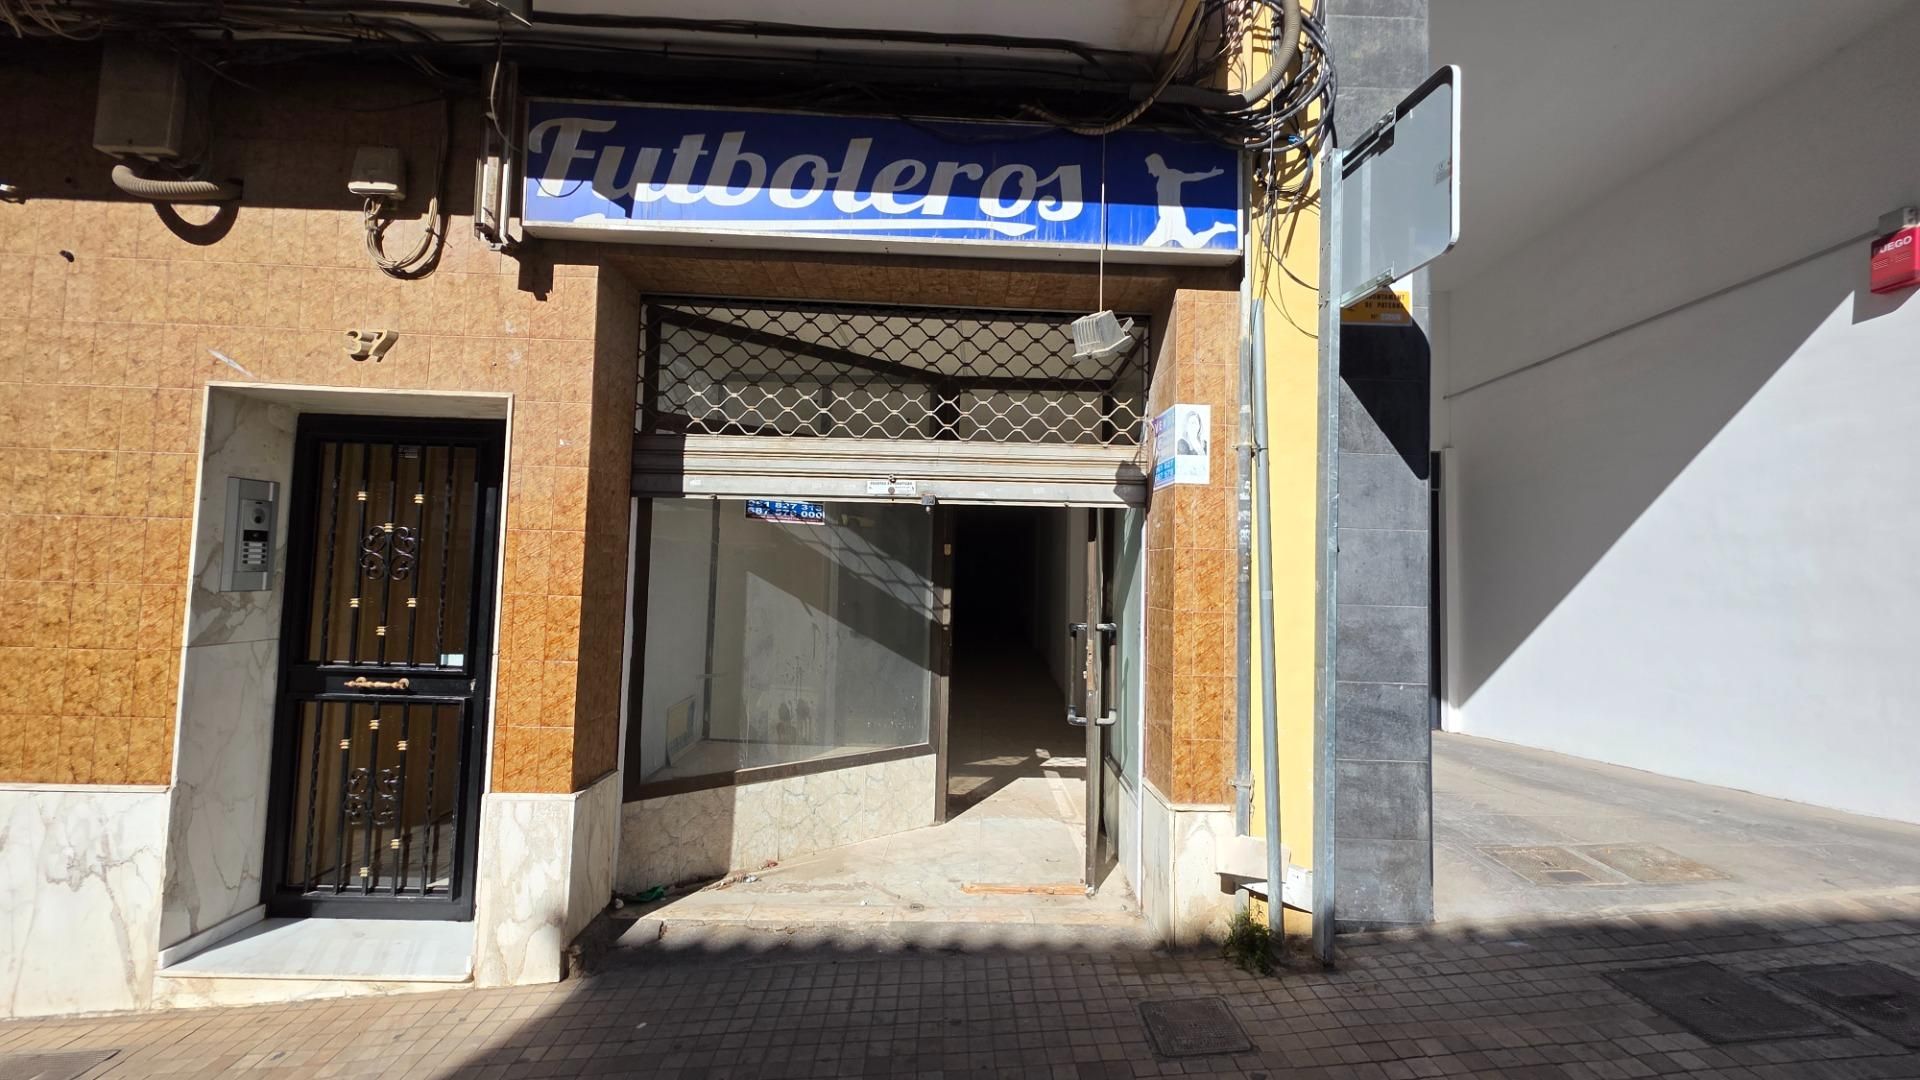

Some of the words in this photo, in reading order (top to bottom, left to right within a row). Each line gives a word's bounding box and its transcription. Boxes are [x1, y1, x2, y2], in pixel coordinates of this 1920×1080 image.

[528, 117, 1084, 222] Futboleros
[343, 329, 399, 362] 37
[775, 502, 798, 511] 827
[801, 510, 823, 519] 000
